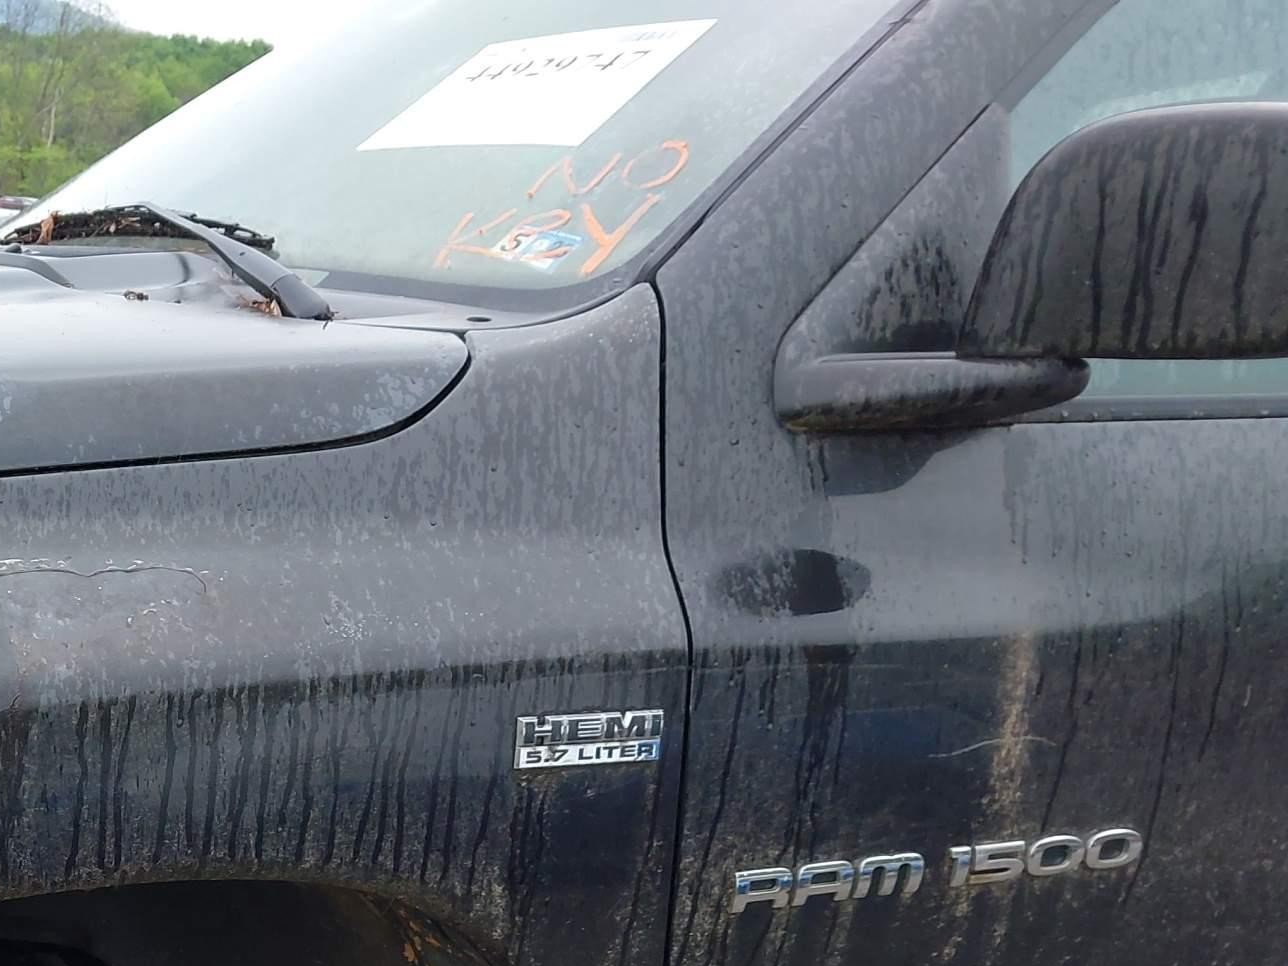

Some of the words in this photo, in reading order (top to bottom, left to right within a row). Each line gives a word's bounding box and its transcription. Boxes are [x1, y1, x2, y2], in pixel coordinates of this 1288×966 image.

[527, 139, 689, 199] NO
[515, 710, 664, 747] HEMI
[523, 749, 570, 764] 5.7
[577, 741, 657, 762] LITER
[729, 852, 925, 914] RAM
[948, 827, 1144, 888] 1500
